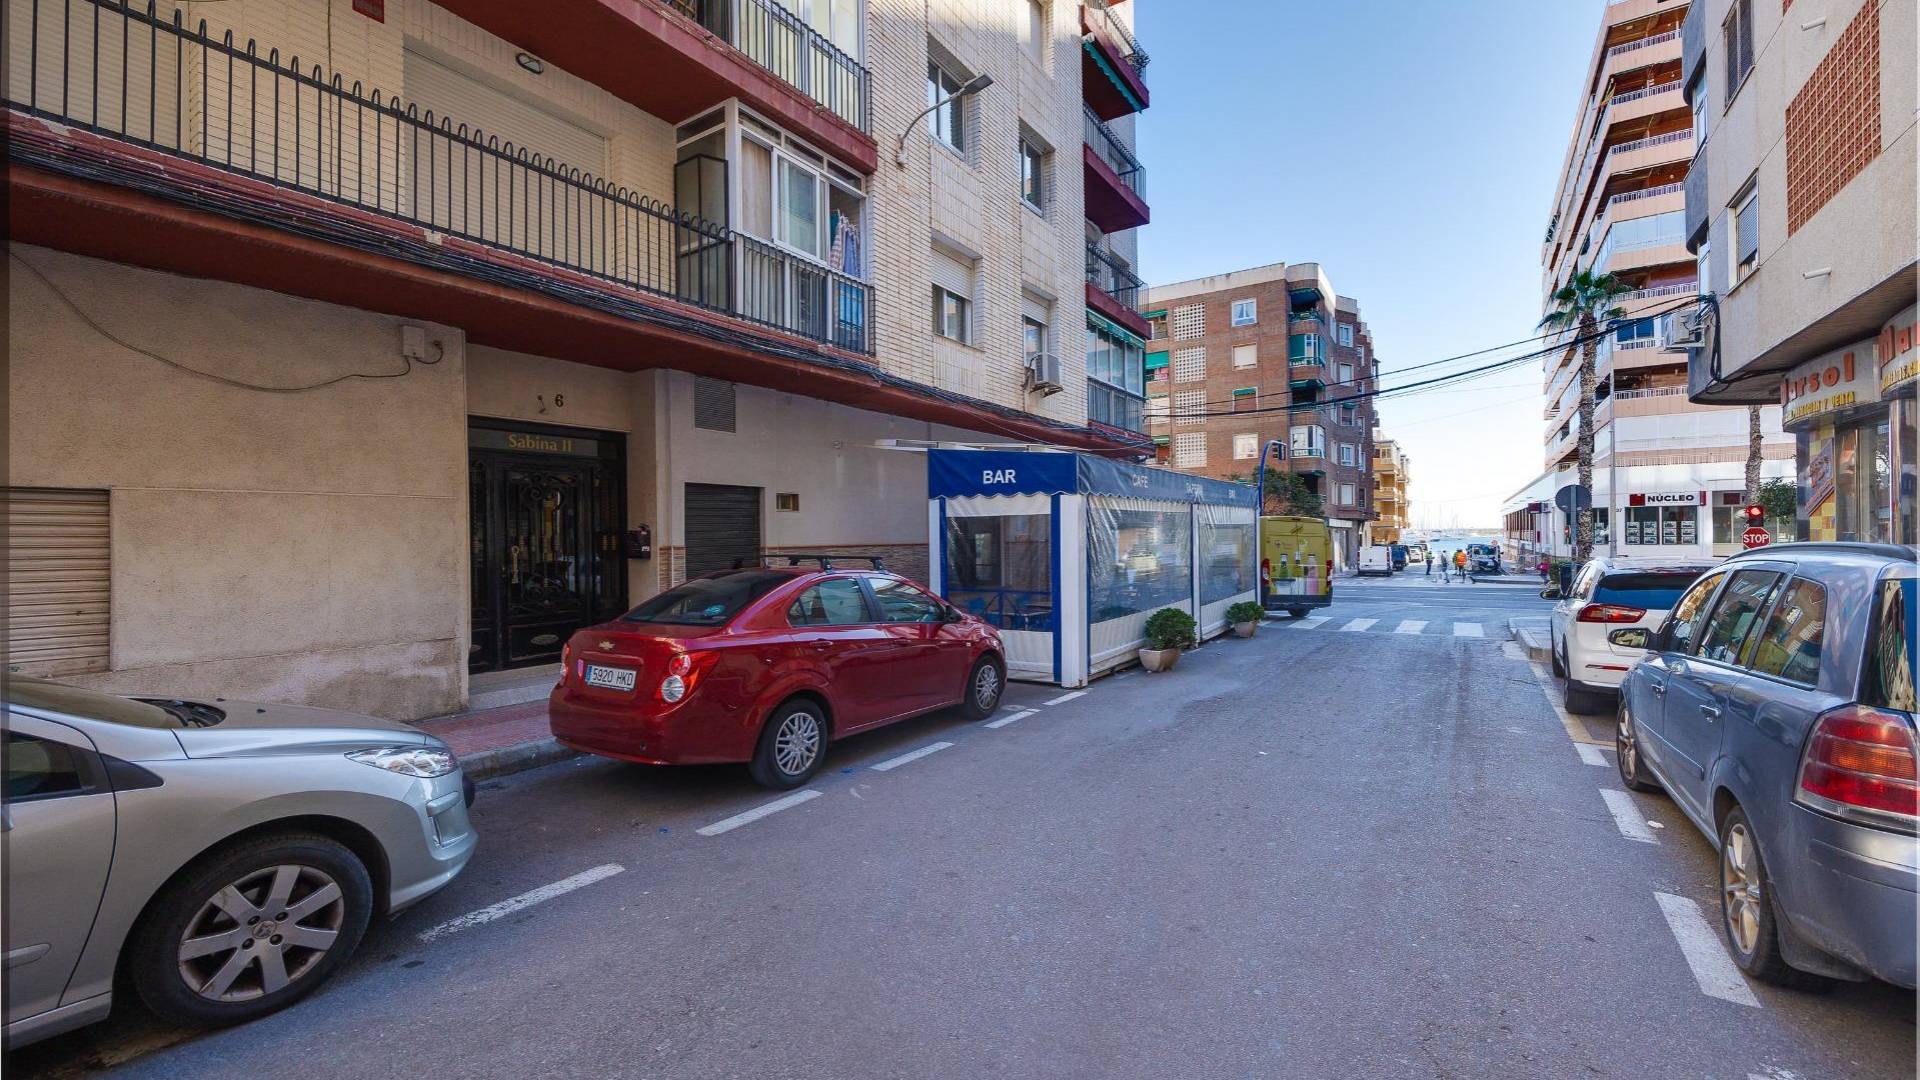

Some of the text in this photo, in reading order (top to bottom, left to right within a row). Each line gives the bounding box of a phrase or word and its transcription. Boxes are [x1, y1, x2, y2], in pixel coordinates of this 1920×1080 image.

[555, 394, 564, 407] 6
[508, 434, 572, 452] Sabina II
[982, 469, 1017, 485] BAR
[1647, 493, 1695, 503] NÚCLEO
[1743, 533, 1769, 544] STOP
[593, 668, 633, 686] 5920 HKD
